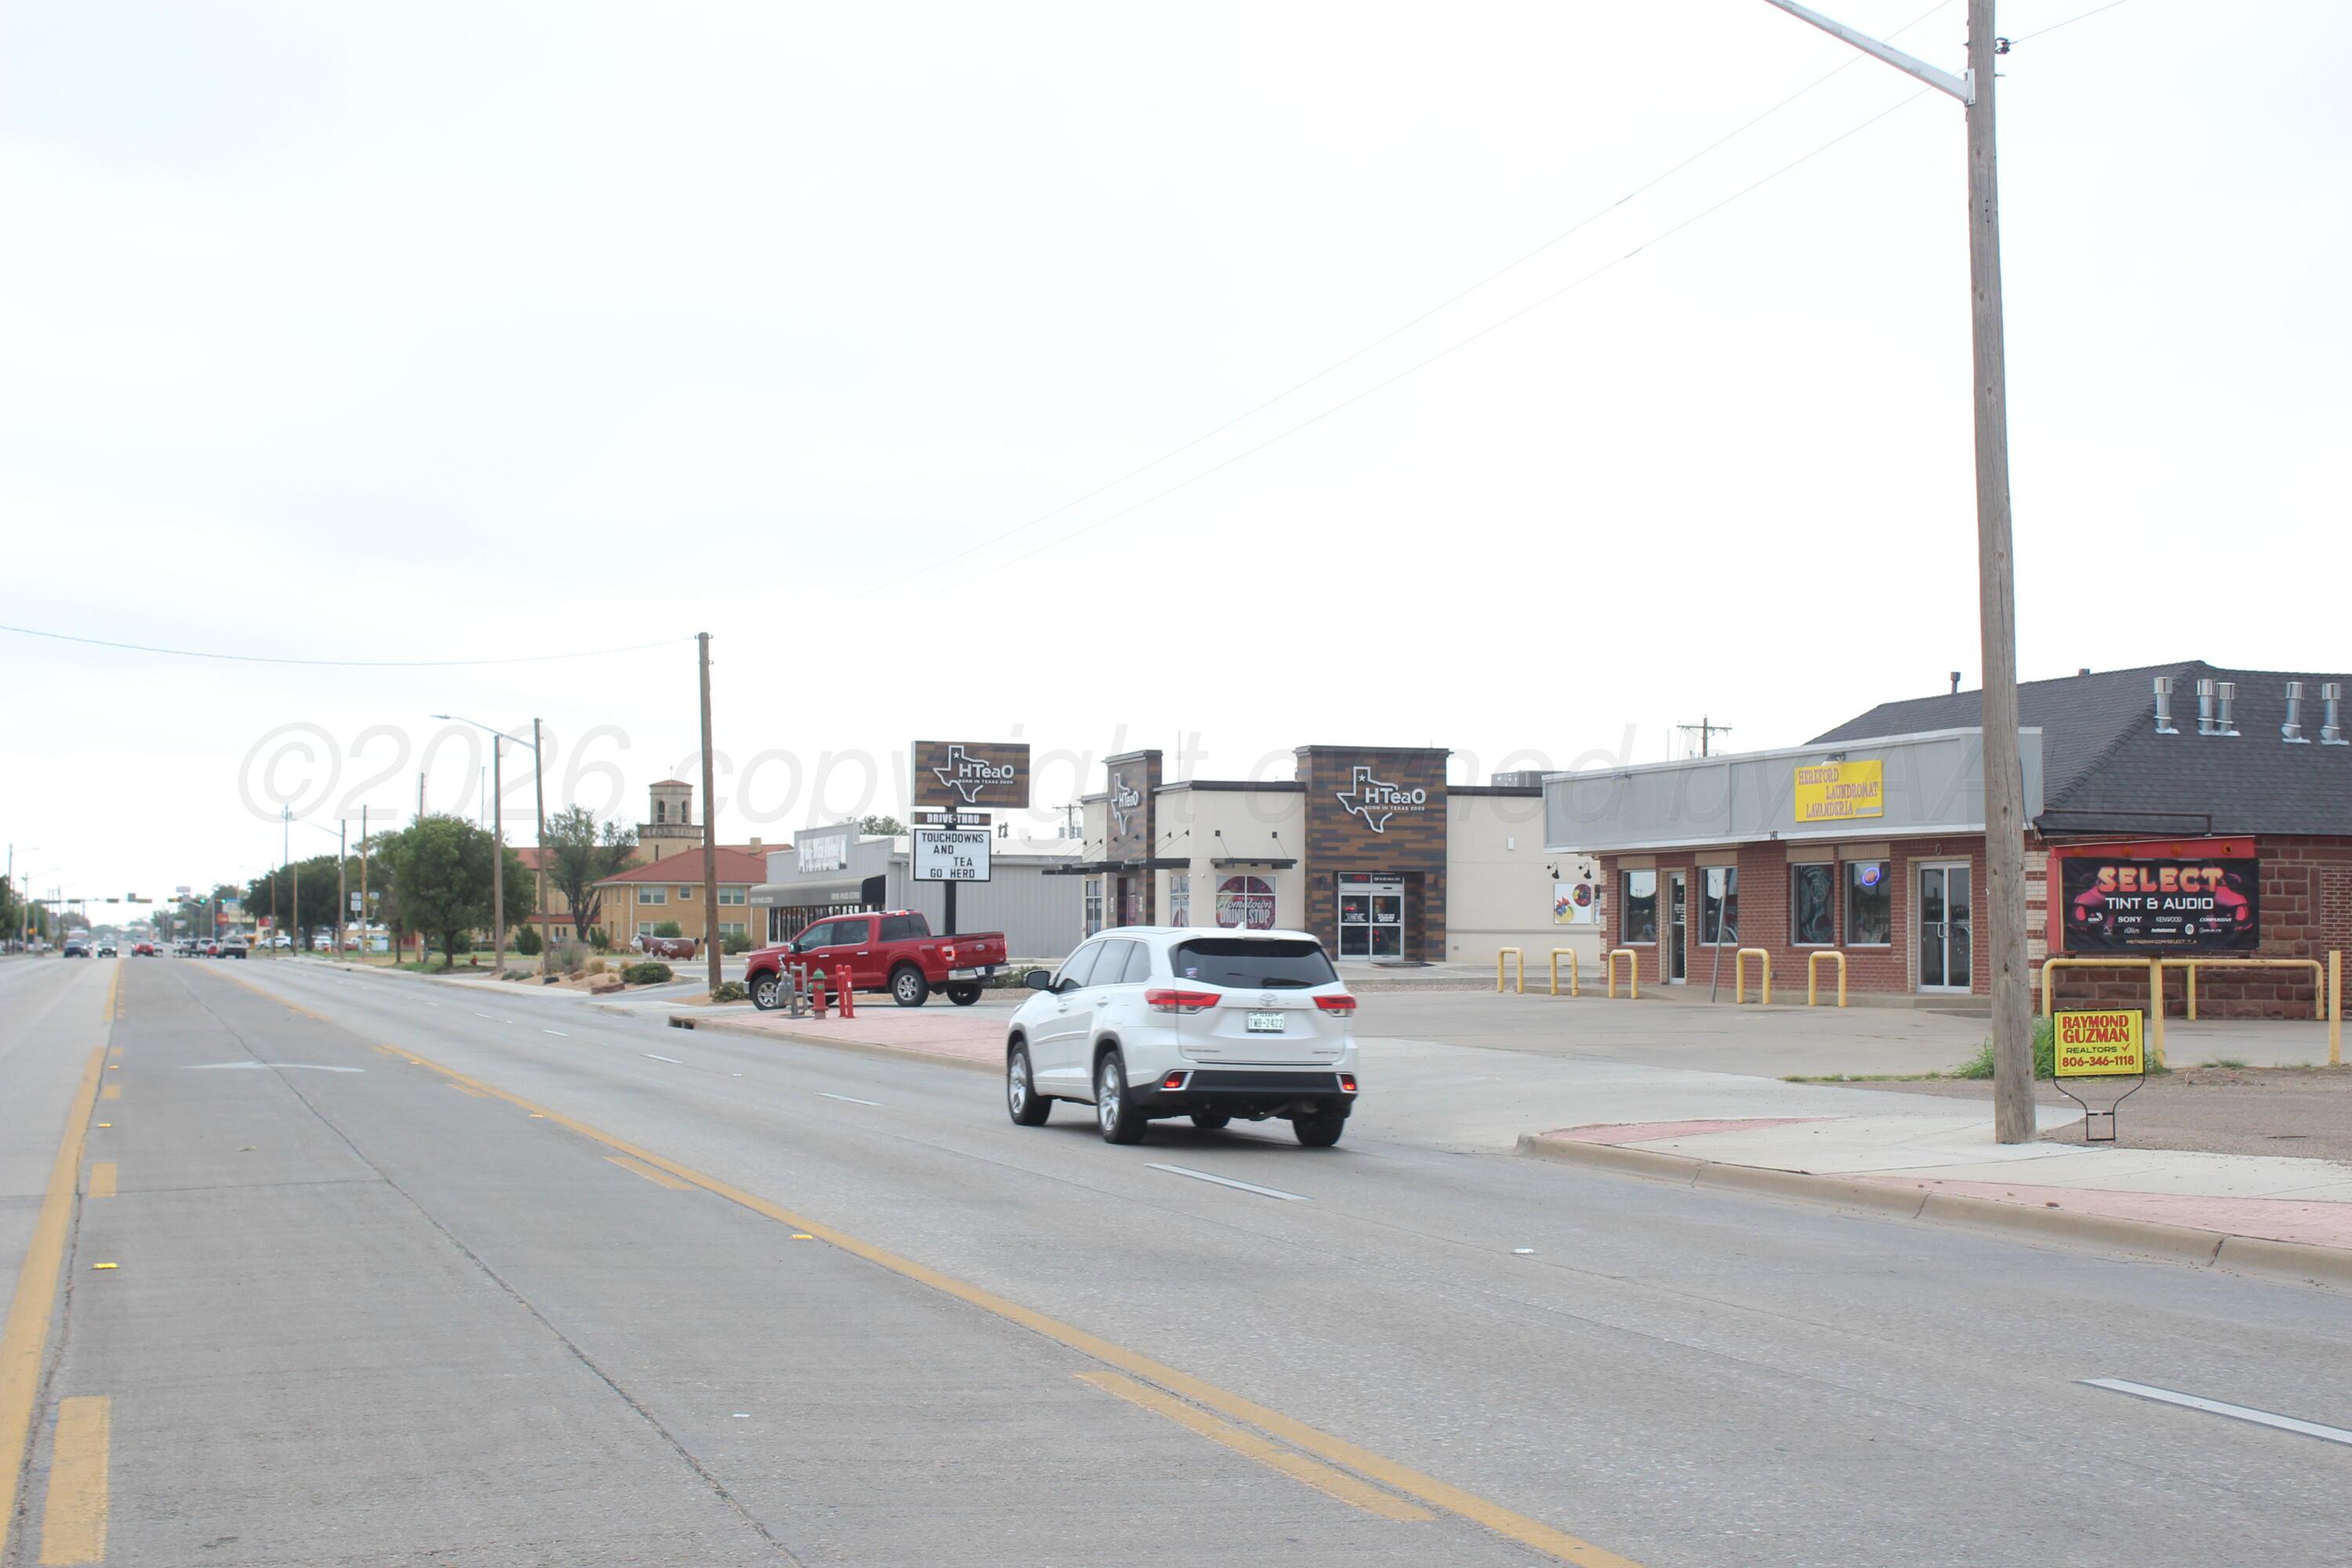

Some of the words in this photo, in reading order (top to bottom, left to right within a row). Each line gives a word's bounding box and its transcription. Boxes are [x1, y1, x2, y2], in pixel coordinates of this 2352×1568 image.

[959, 763, 1014, 779] HTeaO
[1798, 768, 1839, 786] HEREFORD
[1365, 787, 1426, 804] HTeaO
[1826, 781, 1879, 800] LAUNDROMAT
[1806, 800, 1853, 818] LAVANDERIA
[927, 813, 980, 824] DRIVE-THRU
[921, 832, 984, 844] TOUCHDOWNS
[933, 844, 954, 855] AND
[953, 857, 973, 867] TEA
[930, 868, 942, 878] GO
[950, 868, 975, 879] HERD
[2097, 866, 2224, 892] SELECT
[2104, 897, 2142, 910] TINT
[2146, 897, 2157, 910] &
[2162, 897, 2214, 910] AUDIO
[1248, 908, 1271, 924] STOP
[2062, 1015, 2129, 1029] RAYMOND
[2063, 1028, 2129, 1044] GUZMAN
[2062, 1055, 2135, 1067] 806-346-1118
